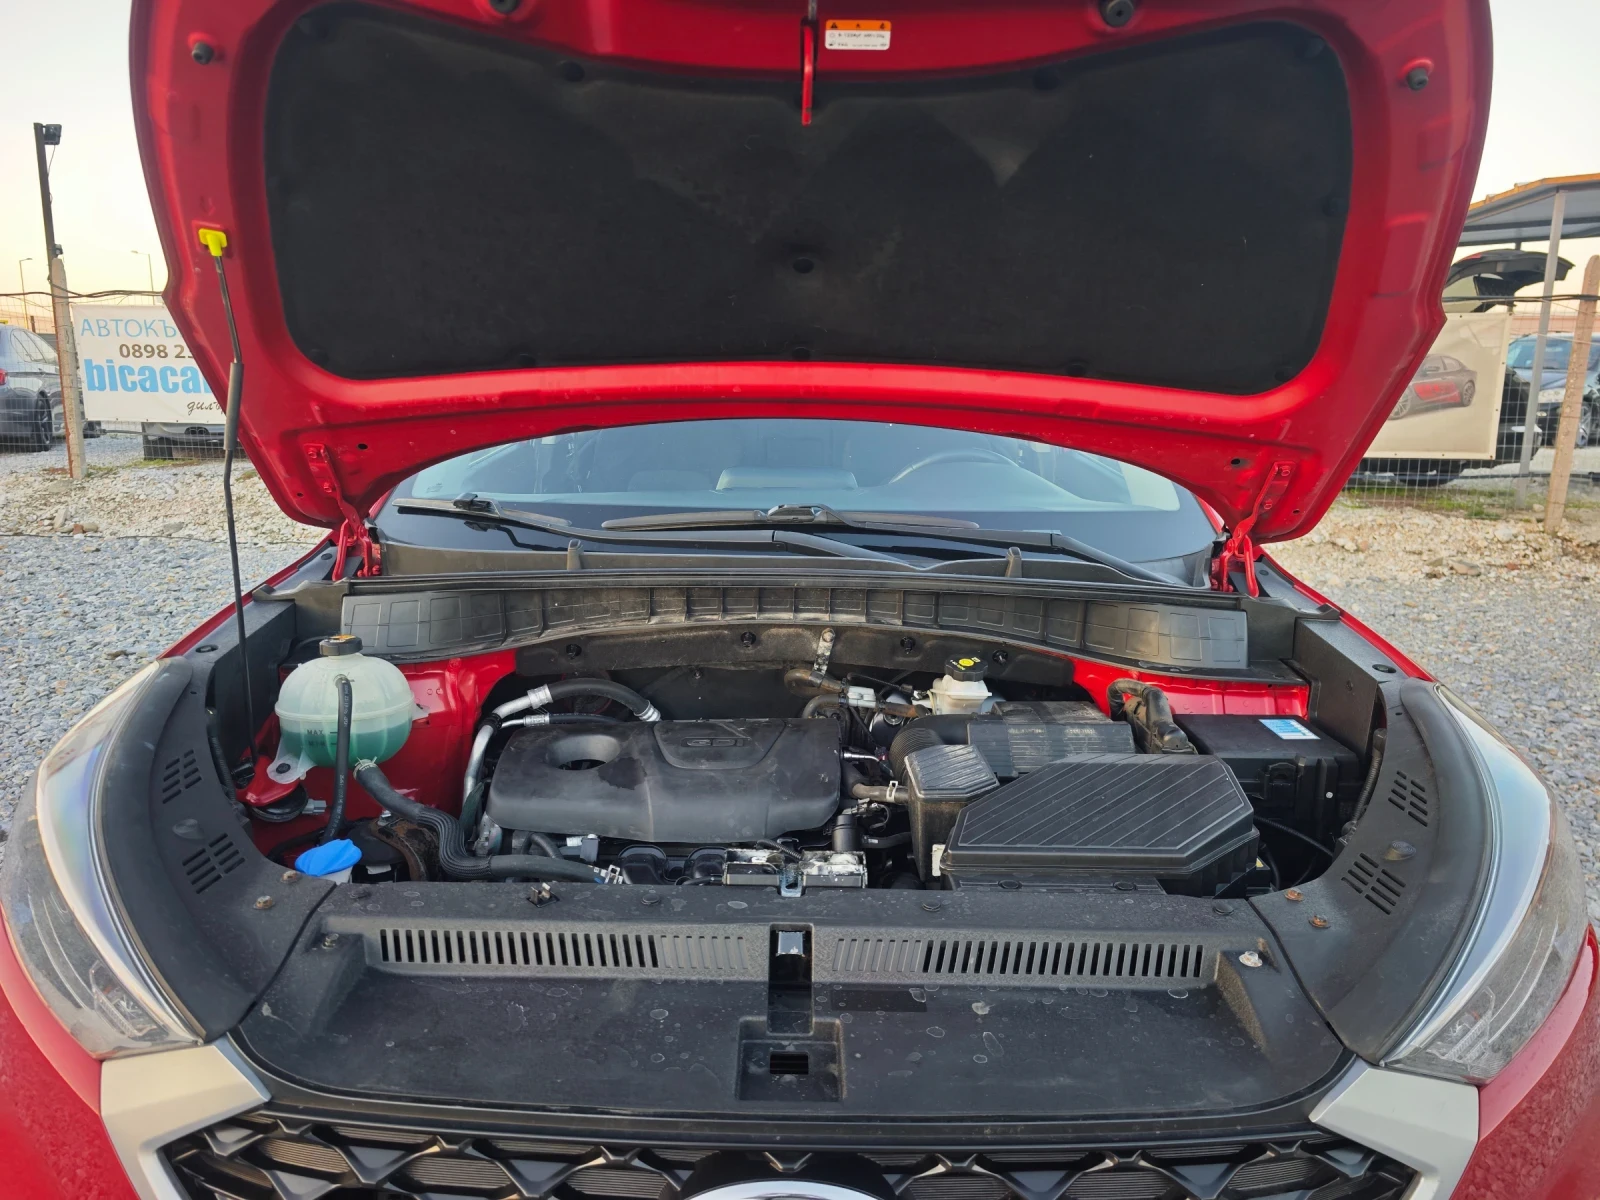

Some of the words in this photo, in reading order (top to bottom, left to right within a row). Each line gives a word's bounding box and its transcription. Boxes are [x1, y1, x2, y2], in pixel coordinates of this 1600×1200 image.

[81, 318, 177, 338] АВТОКЪ
[119, 343, 169, 358] 0898
[174, 344, 195, 359] 2
[186, 401, 226, 416] дилъ
